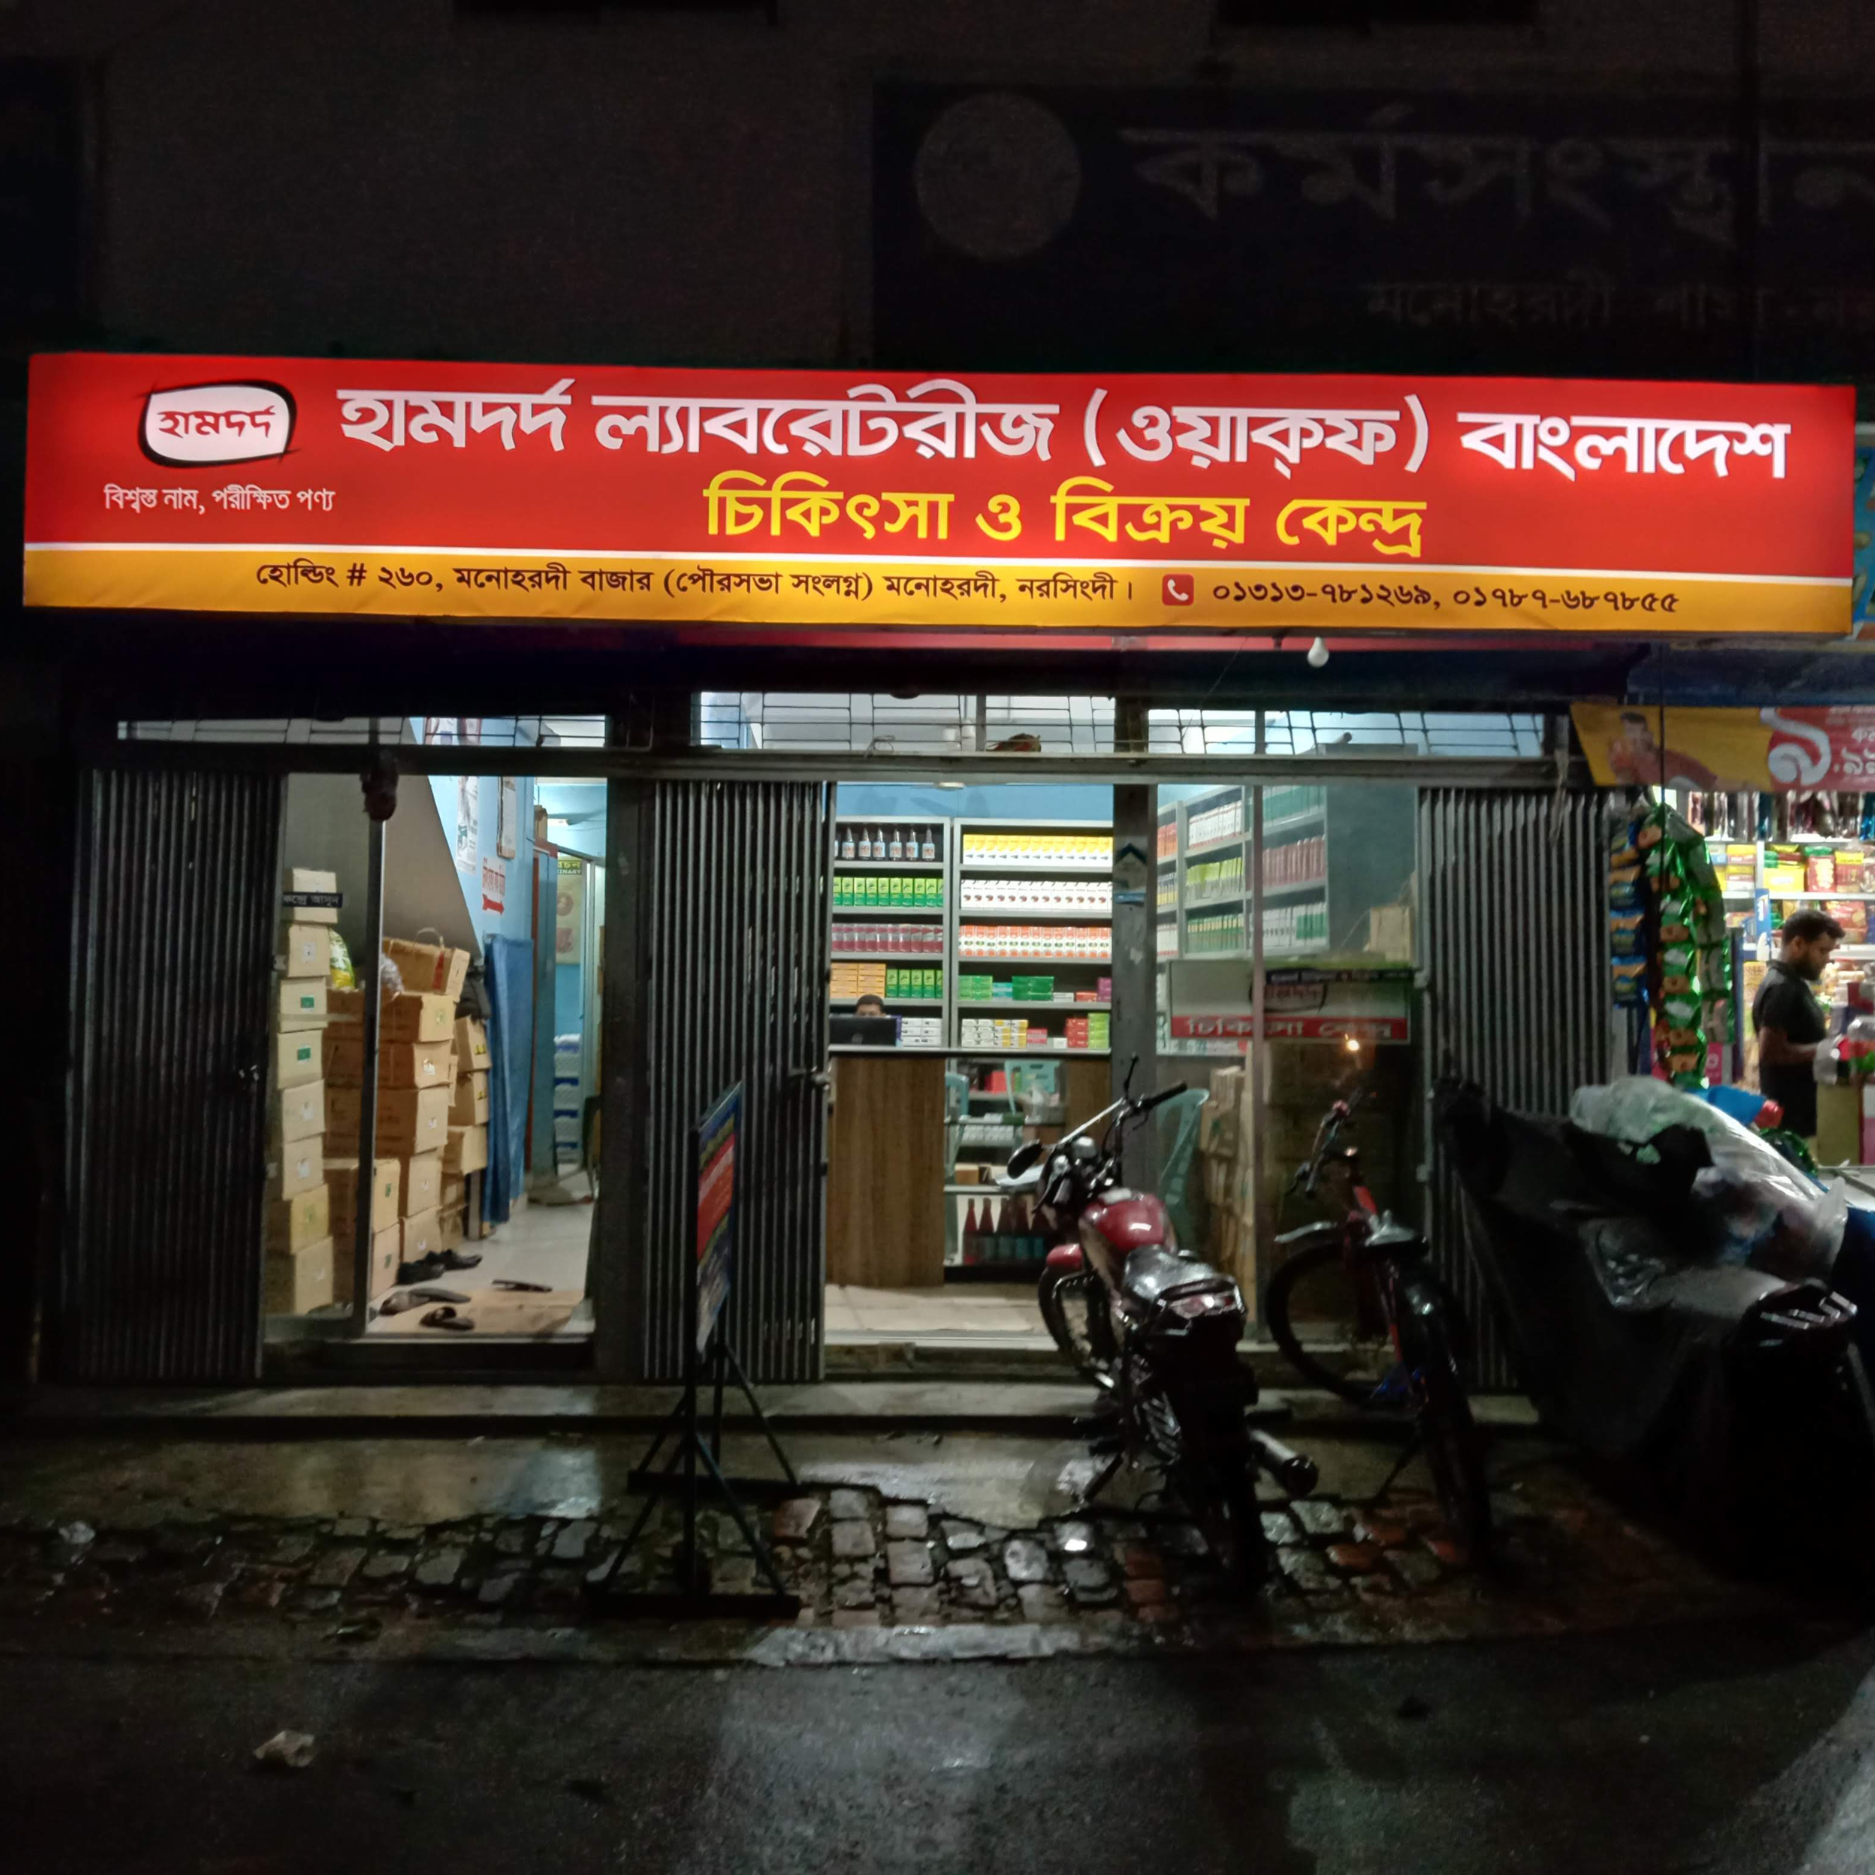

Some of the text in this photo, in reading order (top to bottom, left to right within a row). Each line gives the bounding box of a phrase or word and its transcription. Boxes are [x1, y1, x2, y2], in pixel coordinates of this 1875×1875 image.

[157, 405, 276, 438] হামদর্দ
[336, 378, 575, 453] হামদর্দ
[592, 379, 1060, 461] ল্যাবরেটরীজ
[1457, 412, 1792, 482] বাংলাদেশ
[103, 483, 336, 515] বিশ্বস্ত নাম, পরীক্ষিত পণ্য
[702, 470, 1428, 558] চিকিৎসা ও বিক্রয় কেন্দ্র
[256, 557, 339, 589] হোল্ডিং
[346, 562, 368, 587] #
[378, 566, 443, 592] ২৬০,
[452, 561, 571, 593] মনোহরদী
[579, 568, 655, 593] বাজার
[663, 564, 783, 599] (পৌরসভা
[789, 571, 873, 602] সংলগ্ন)
[882, 569, 1007, 603] মনোহরদী,
[1212, 580, 1441, 611] ০১৩১৩-৭৮১২৬৯,
[1452, 586, 1680, 613] ০১৭৮৭-৬৮৭৮৫৫
[1185, 1015, 1305, 1037] চিকিসা
